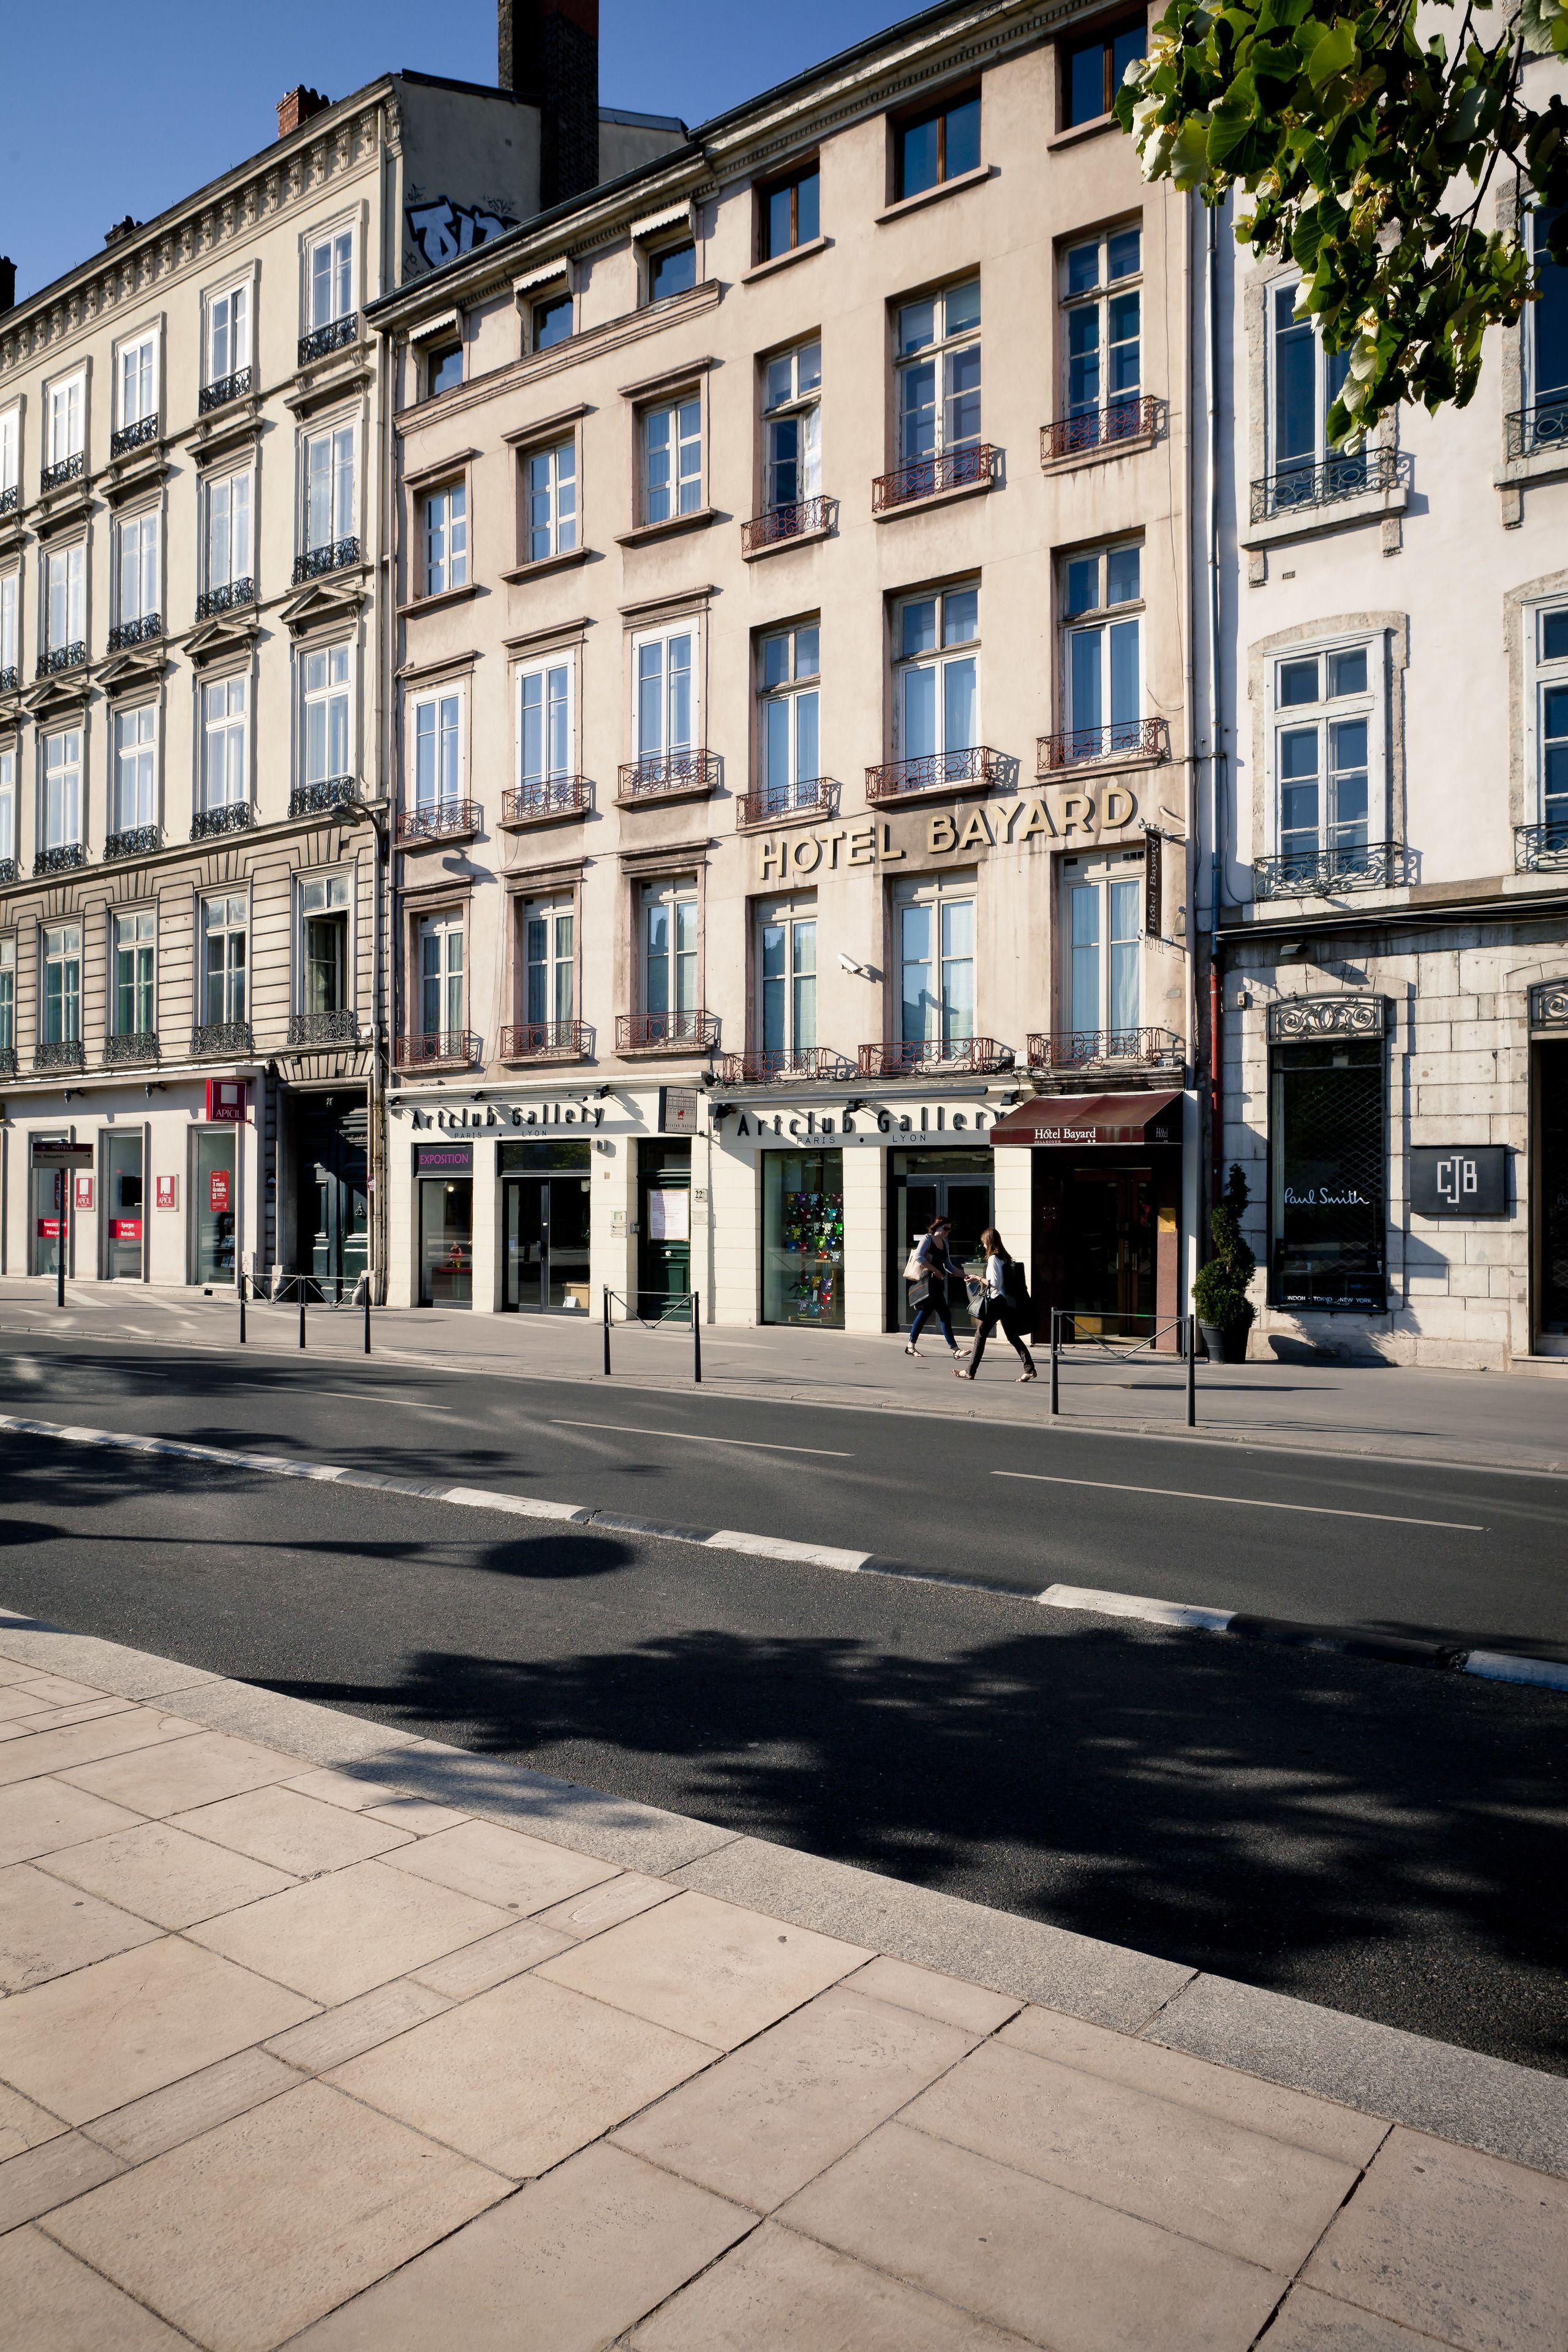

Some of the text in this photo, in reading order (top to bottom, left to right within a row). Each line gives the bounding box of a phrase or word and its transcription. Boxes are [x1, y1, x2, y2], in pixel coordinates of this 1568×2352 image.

[759, 786, 1134, 879] HOTEL BAYARD
[1149, 837, 1158, 887] Bayard
[1145, 935, 1165, 955] HOTEL
[216, 1109, 242, 1118] APICIL
[412, 1103, 605, 1130] Artclub Gallery
[737, 1109, 854, 1136] Artclub
[892, 1134, 926, 1142] LYON
[1034, 1127, 1096, 1140] Hôtel Bayard
[420, 1153, 469, 1164] EXPOSITION
[695, 1190, 703, 1199] 22
[1284, 1187, 1370, 1205] Paul Smith
